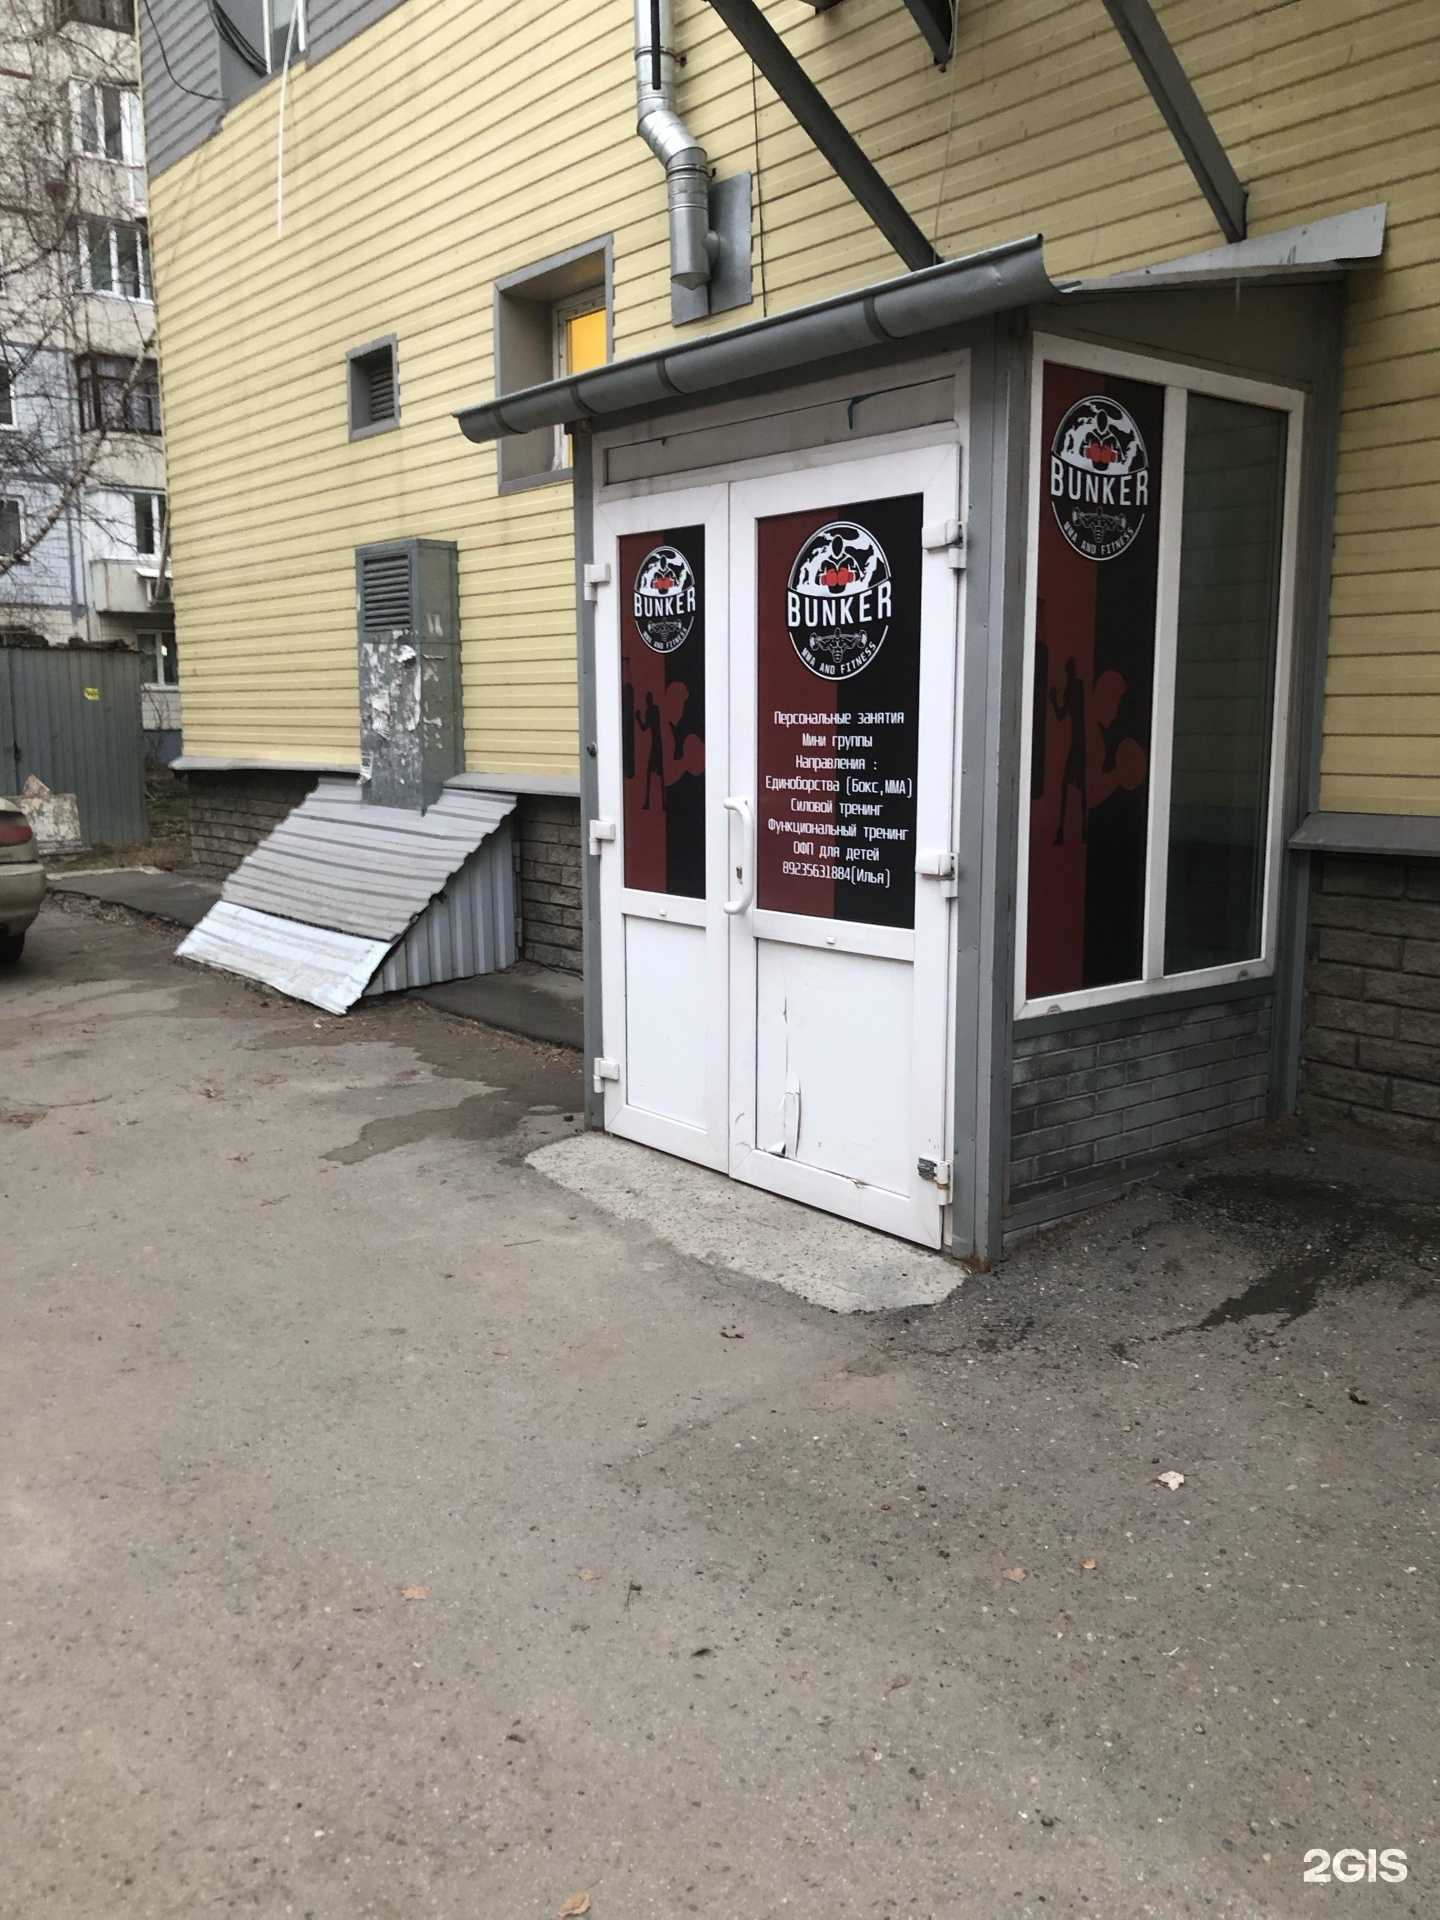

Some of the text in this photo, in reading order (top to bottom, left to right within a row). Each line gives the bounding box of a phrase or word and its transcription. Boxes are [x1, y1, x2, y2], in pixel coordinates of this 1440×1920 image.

[1050, 455, 1148, 506] BUNKER
[1081, 541, 1097, 555] AND
[1101, 526, 1134, 555] FITNESS
[634, 587, 696, 617] BUNKER
[787, 580, 892, 627] BUNKER
[819, 662, 836, 675] AND
[840, 641, 877, 674] FITNESS
[774, 710, 905, 728] Персональные занятия
[802, 733, 873, 750] Мини группы
[795, 754, 865, 772] Направления
[765, 775, 840, 794] Единоборства
[791, 798, 884, 818] Силовой тренинг
[767, 818, 909, 842] Функциональный тренинг
[793, 840, 880, 861] ОФП для детей
